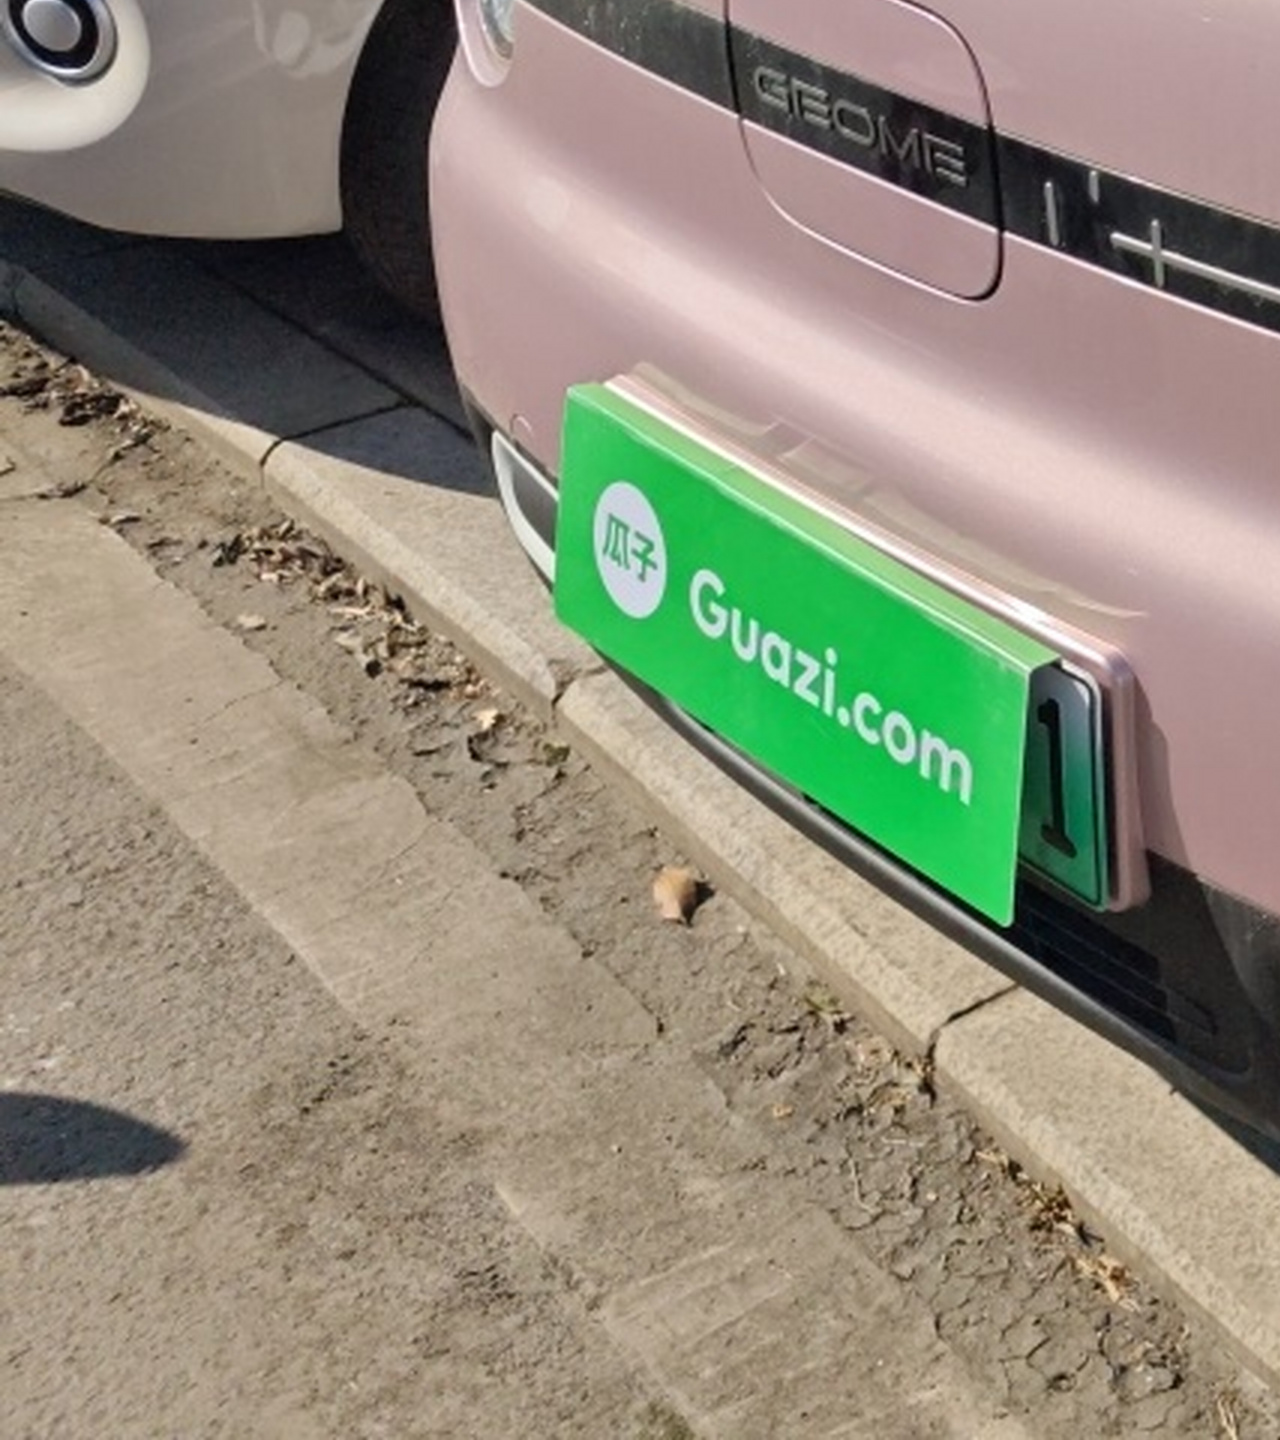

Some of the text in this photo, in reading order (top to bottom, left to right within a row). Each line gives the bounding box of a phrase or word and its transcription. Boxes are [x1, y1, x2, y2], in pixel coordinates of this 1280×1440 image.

[752, 64, 969, 188] GEOME
[602, 512, 658, 583] 瓜子
[689, 568, 973, 807] Guazi.com
[1037, 698, 1078, 859] 1
